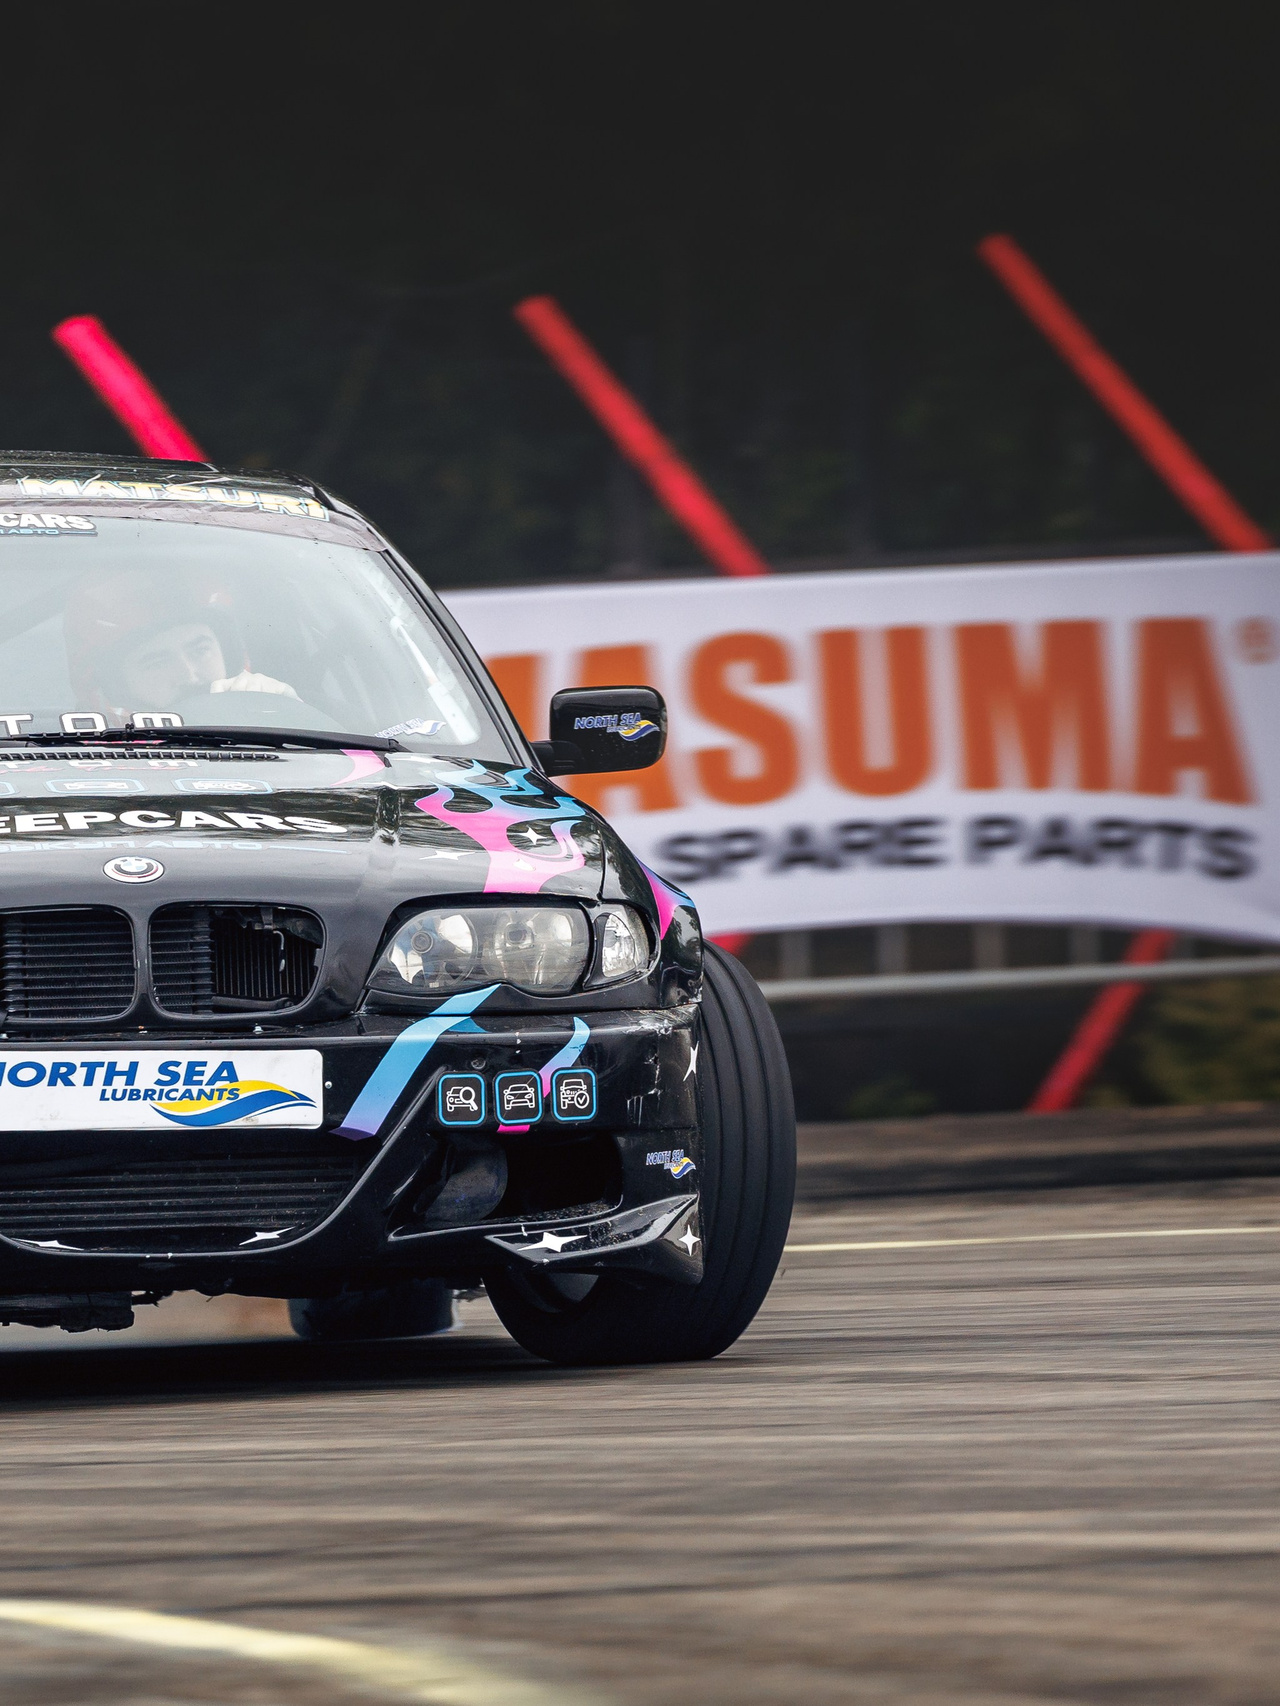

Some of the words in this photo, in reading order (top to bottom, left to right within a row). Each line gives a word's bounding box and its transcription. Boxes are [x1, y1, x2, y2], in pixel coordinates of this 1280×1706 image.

[19, 478, 329, 521] MATSURI
[575, 715, 618, 730] NORTH
[620, 713, 641, 726] SEA
[660, 816, 951, 885] SPARE
[968, 815, 1257, 880] PARTS
[153, 1060, 239, 1087] SEA
[99, 1087, 240, 1101] LUBRICANTS
